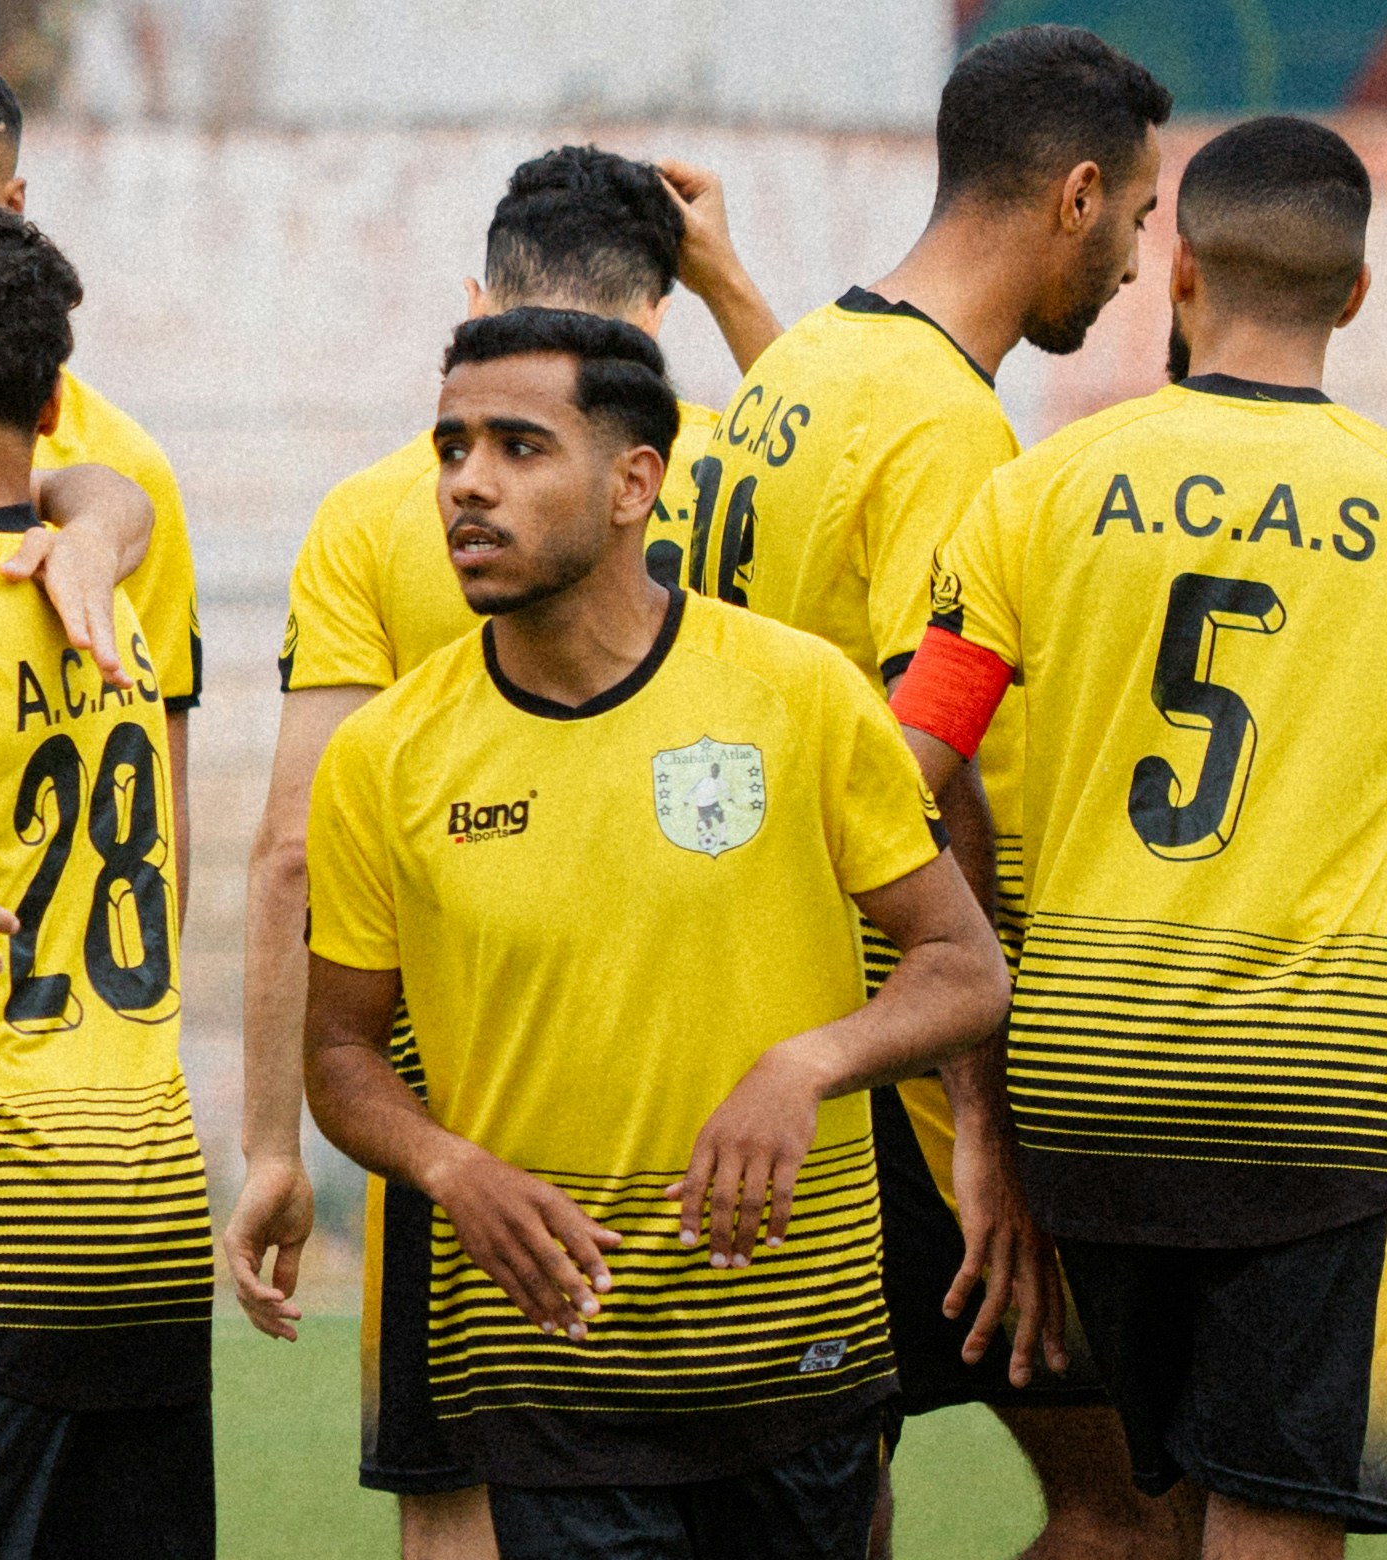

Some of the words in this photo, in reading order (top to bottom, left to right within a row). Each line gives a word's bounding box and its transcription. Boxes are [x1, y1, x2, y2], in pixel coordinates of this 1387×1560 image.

[1091, 473, 1381, 563] A.C.A.S
[1127, 571, 1288, 863] 5
[720, 746, 753, 762] Atlas
[447, 799, 530, 836] Bang
[465, 826, 509, 845] Sports
[3, 721, 181, 1036] 28
